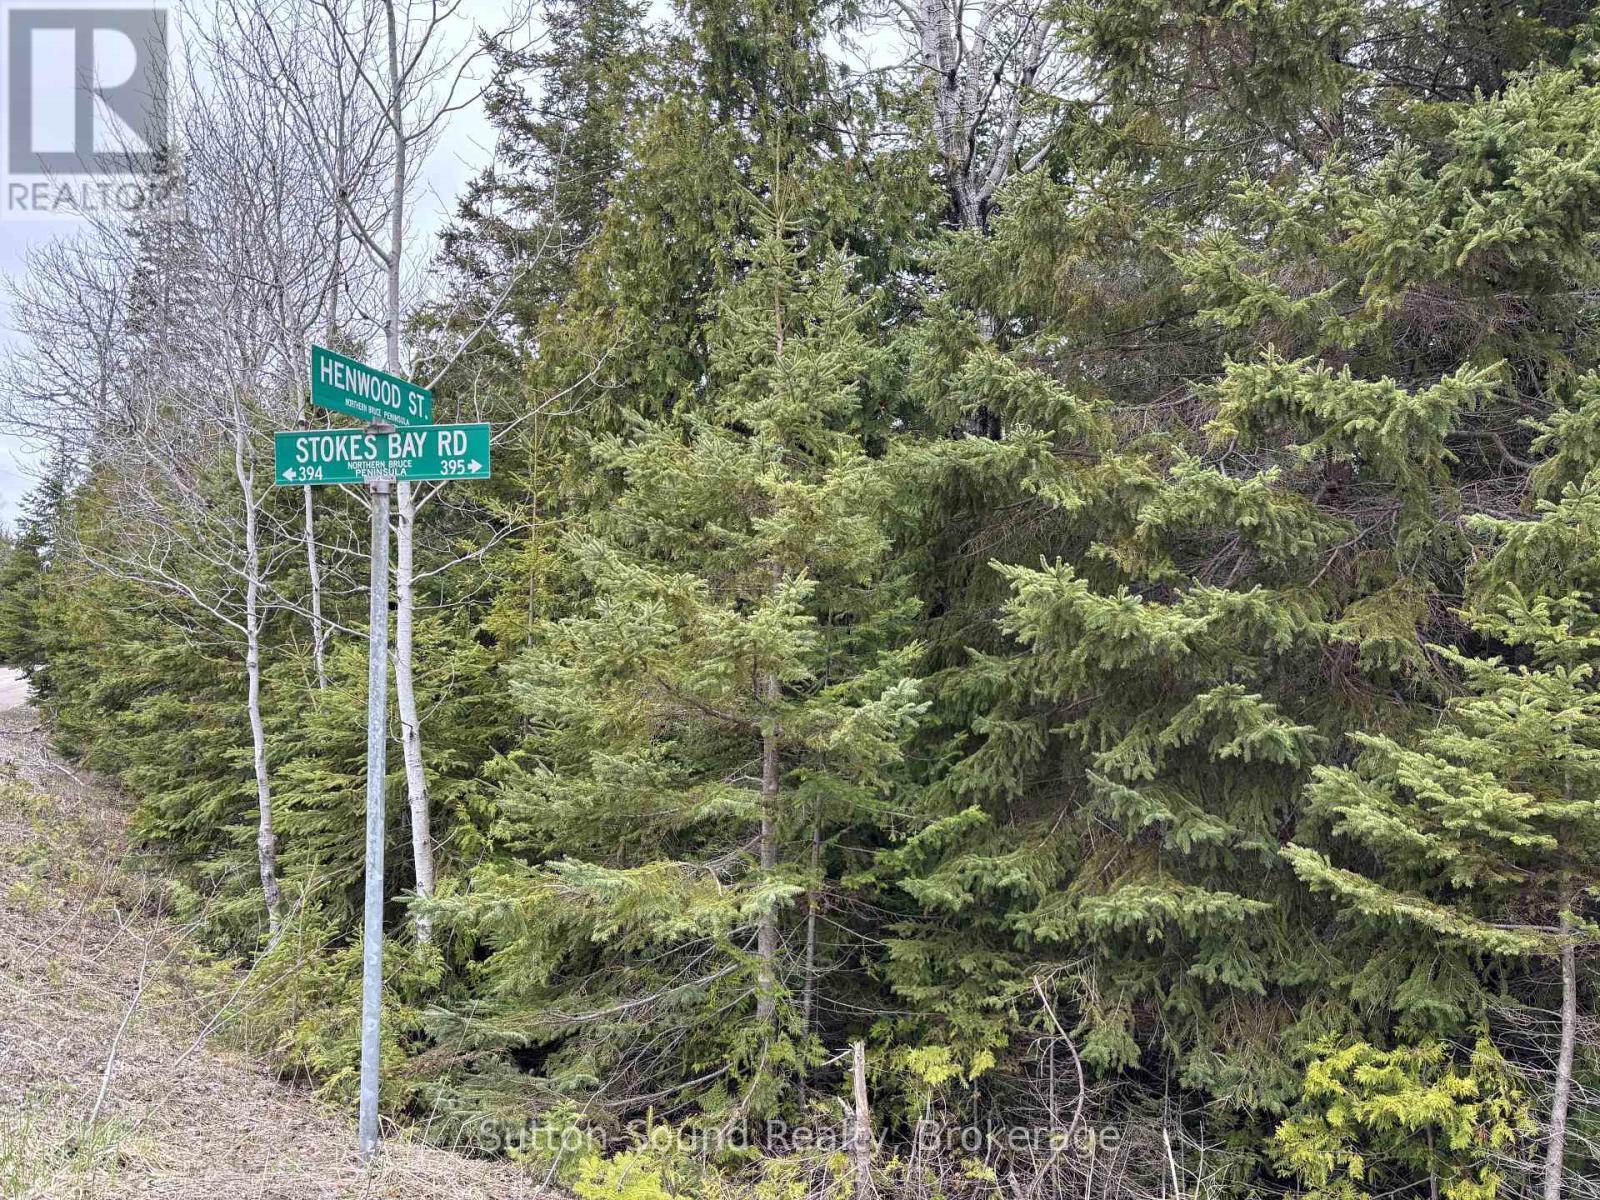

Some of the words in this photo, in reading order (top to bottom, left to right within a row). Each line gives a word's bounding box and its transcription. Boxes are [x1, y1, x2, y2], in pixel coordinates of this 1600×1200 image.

[320, 356, 401, 408] HENWOOD
[408, 391, 429, 420] ST.
[345, 398, 368, 412] NORTHERN
[368, 405, 381, 417] BRUCE
[383, 411, 410, 426] PENINSULA
[296, 434, 377, 463] STOKES
[388, 431, 427, 459] BAY
[438, 430, 467, 456] RD
[347, 460, 386, 470] NORTHERN
[388, 459, 412, 468] BRUCE
[355, 467, 407, 477] PENINSULA
[440, 459, 466, 475] 395
[299, 466, 323, 481] 394
